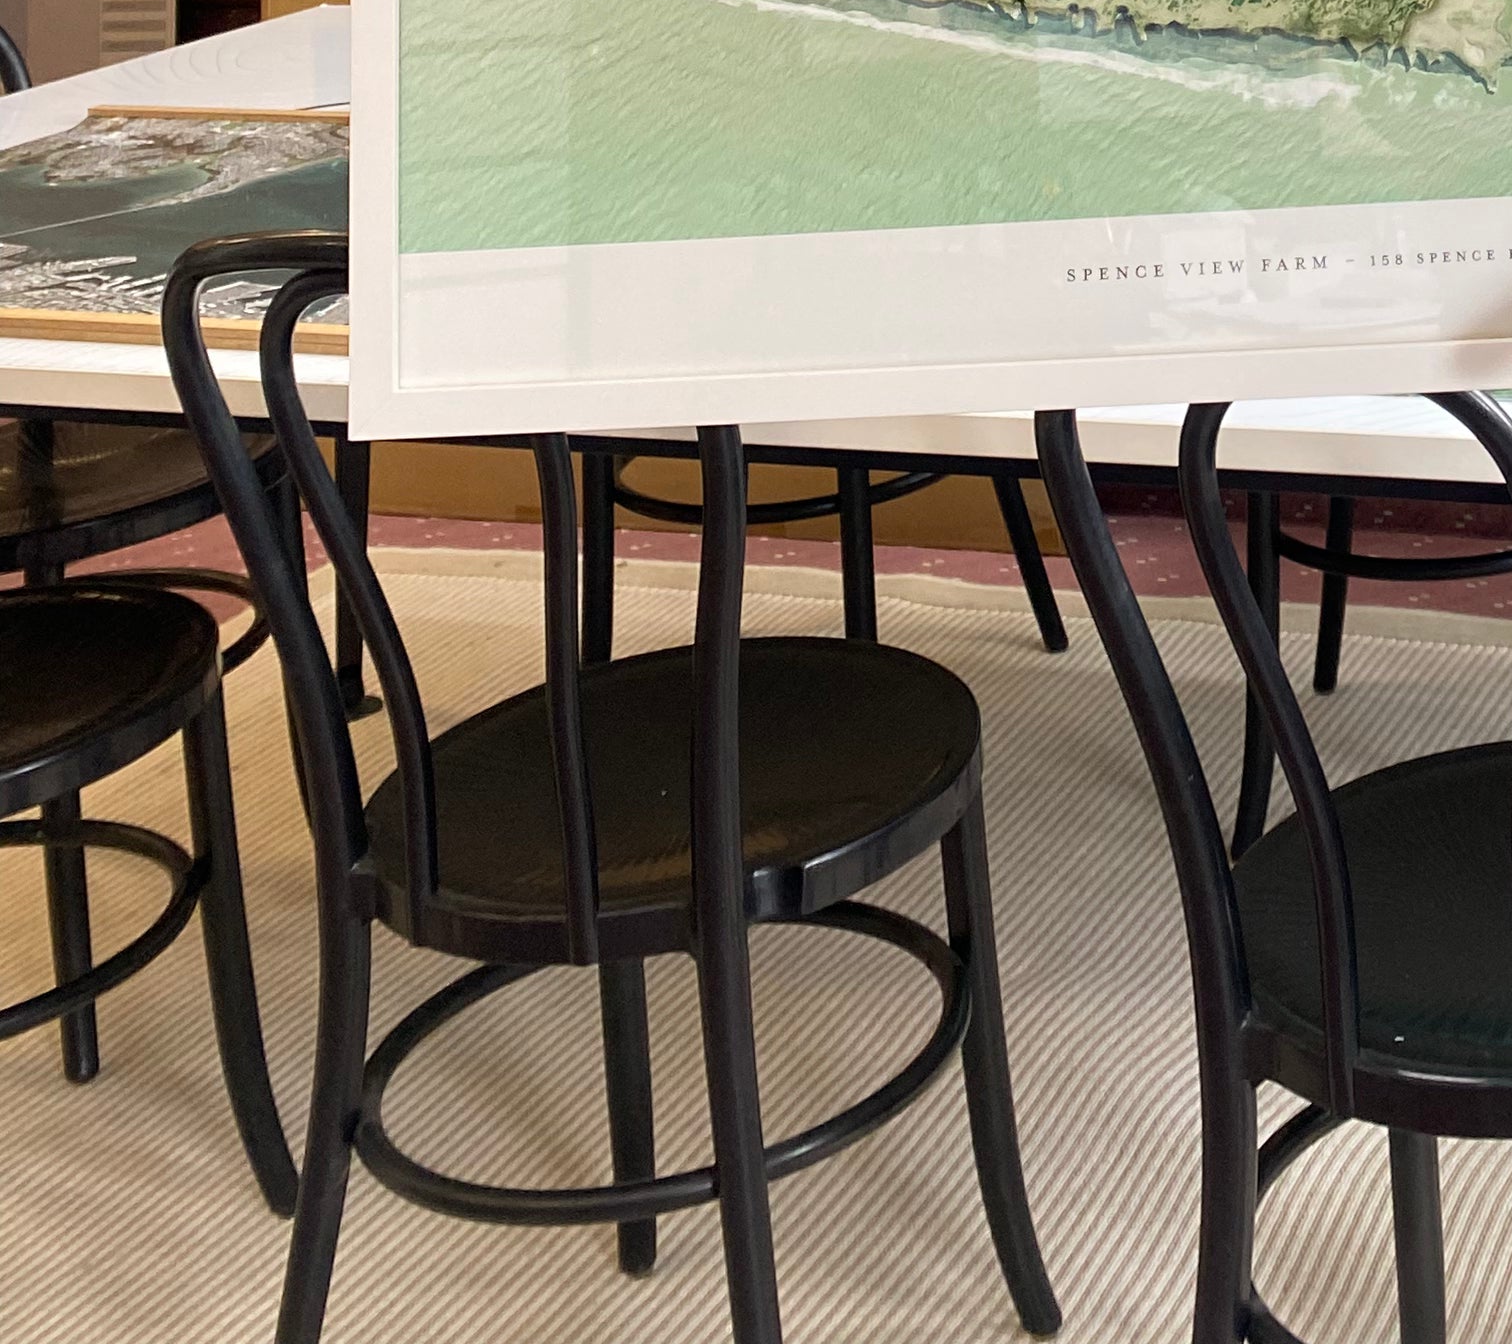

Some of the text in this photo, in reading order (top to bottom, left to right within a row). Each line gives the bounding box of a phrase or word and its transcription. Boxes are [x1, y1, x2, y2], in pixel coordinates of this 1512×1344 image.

[1066, 263, 1164, 283] SPENCE
[1179, 259, 1245, 277] VIEW
[1261, 255, 1328, 273] FARM
[1370, 254, 1403, 268] 158
[1416, 249, 1496, 266] SPENCE
